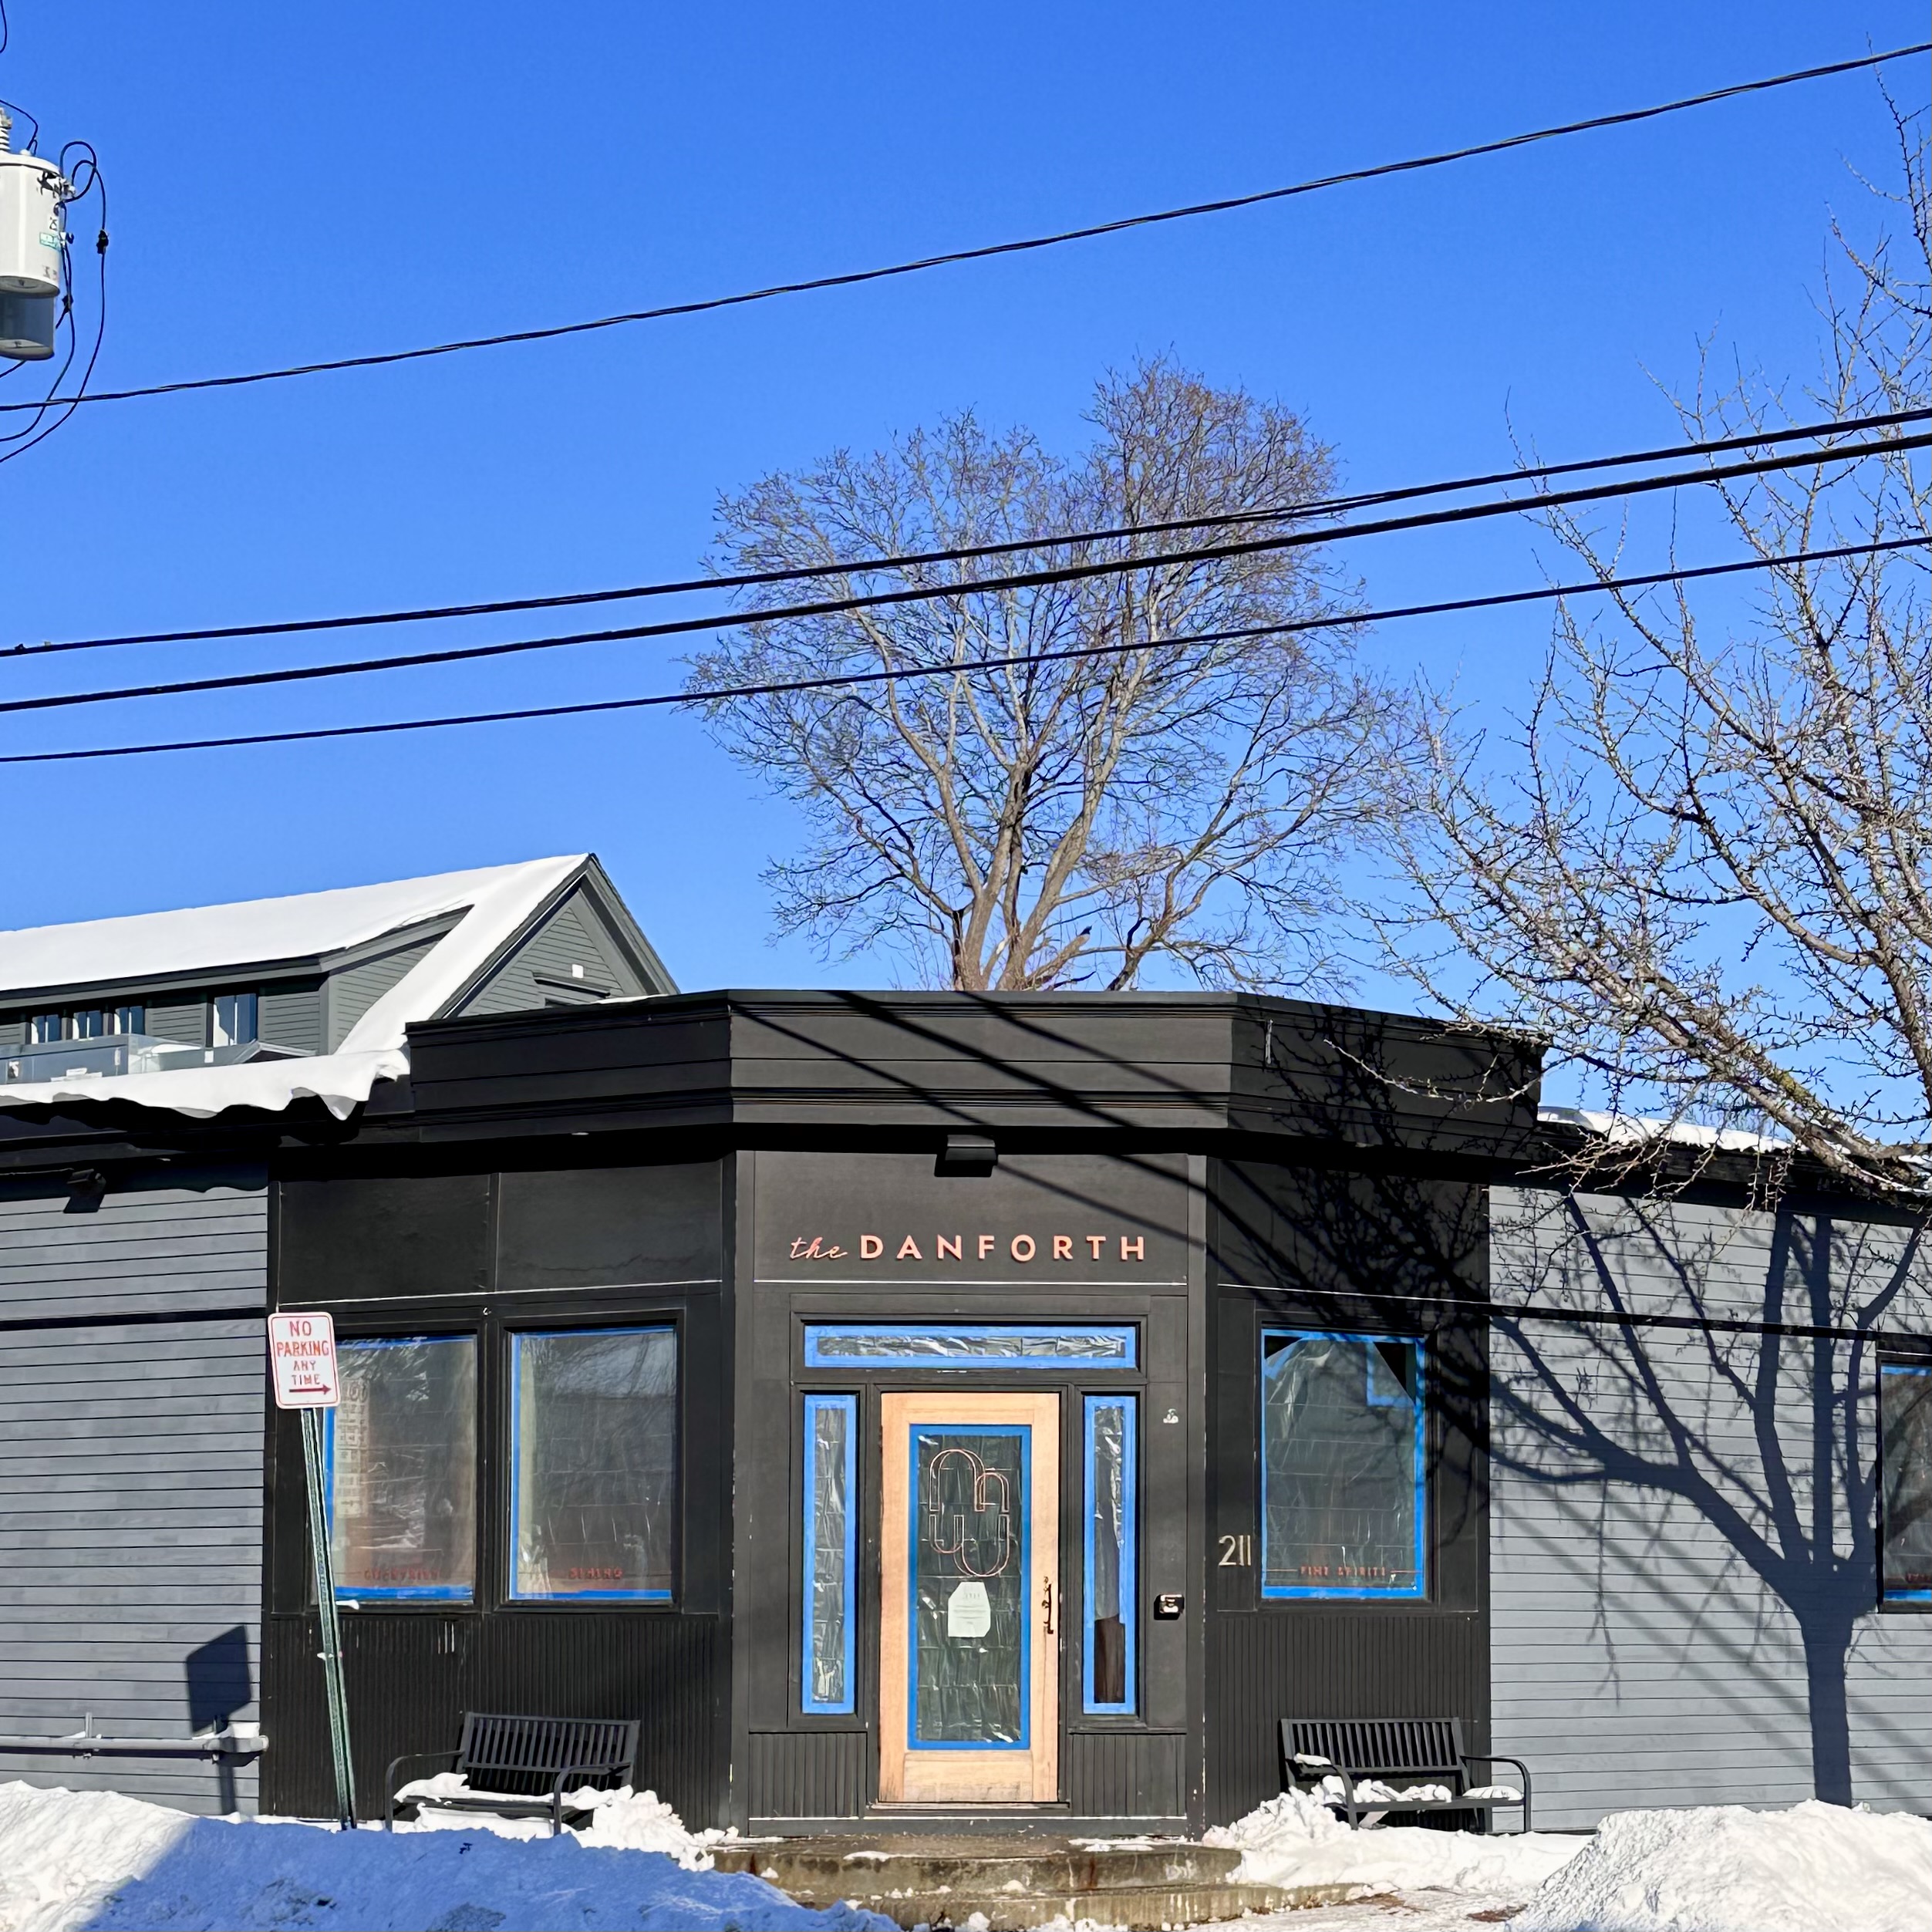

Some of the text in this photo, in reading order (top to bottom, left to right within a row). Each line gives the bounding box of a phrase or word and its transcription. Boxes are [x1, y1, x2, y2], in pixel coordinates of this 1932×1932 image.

[790, 1235, 1145, 1262] the DANFORTH
[289, 1320, 312, 1337] NO
[276, 1340, 329, 1357] PARKING
[293, 1360, 316, 1371] ANY
[292, 1374, 320, 1385] TIME
[1219, 1535, 1251, 1566] 211
